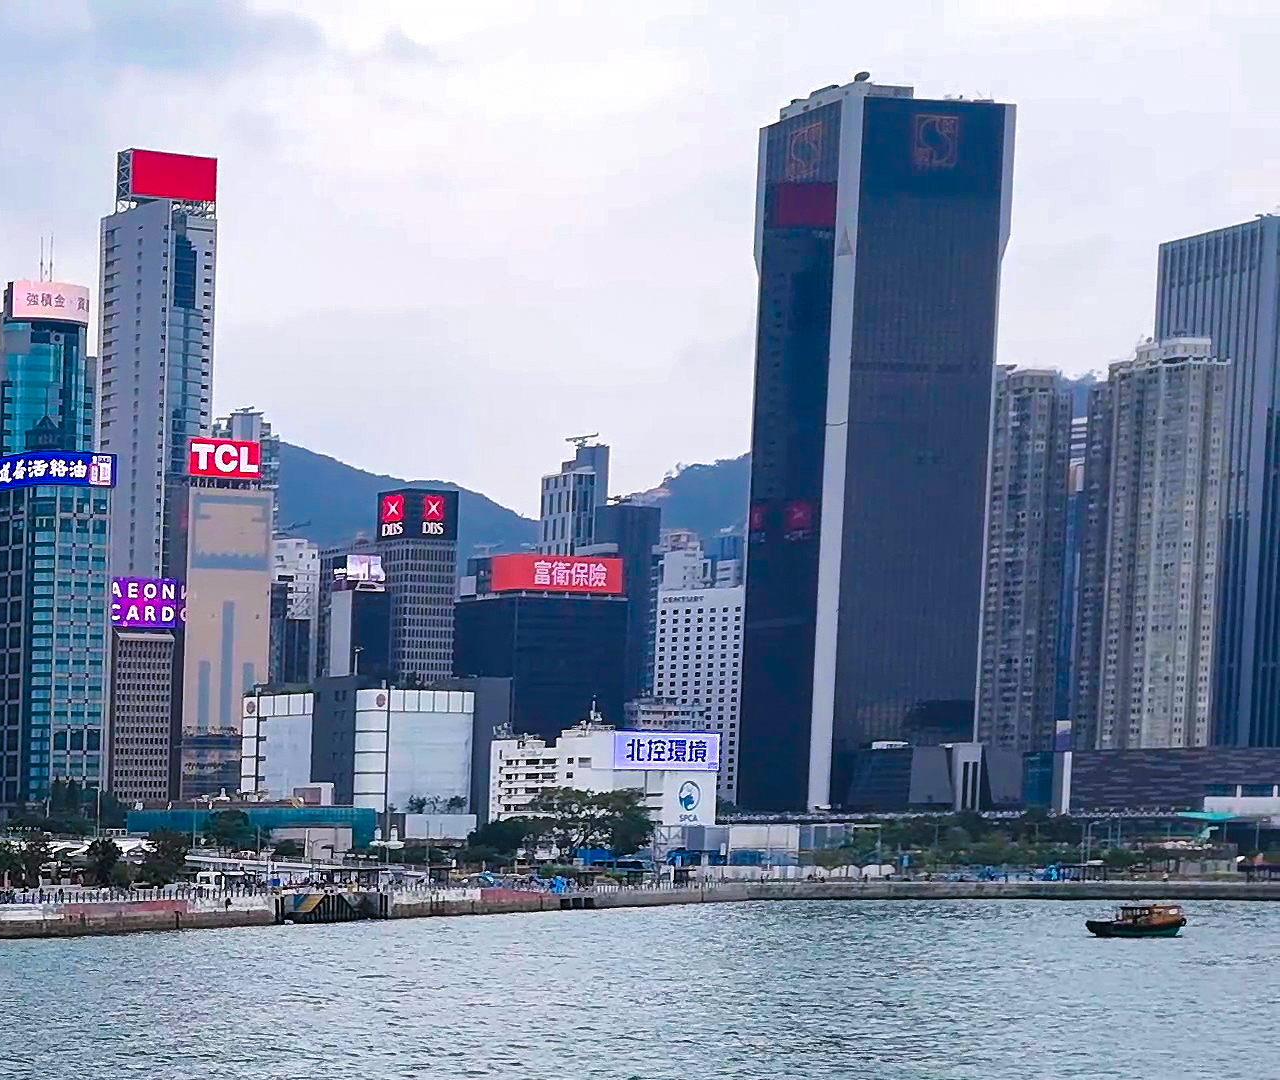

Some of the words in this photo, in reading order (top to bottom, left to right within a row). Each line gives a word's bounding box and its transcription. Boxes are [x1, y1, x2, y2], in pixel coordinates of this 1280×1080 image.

[191, 442, 259, 473] TCL
[381, 521, 404, 537] DBS
[421, 520, 444, 535] DBS
[533, 560, 608, 588] 富衛保險
[112, 581, 175, 600] AEON
[626, 738, 708, 762] 北控環境
[679, 814, 699, 823] SPCA
